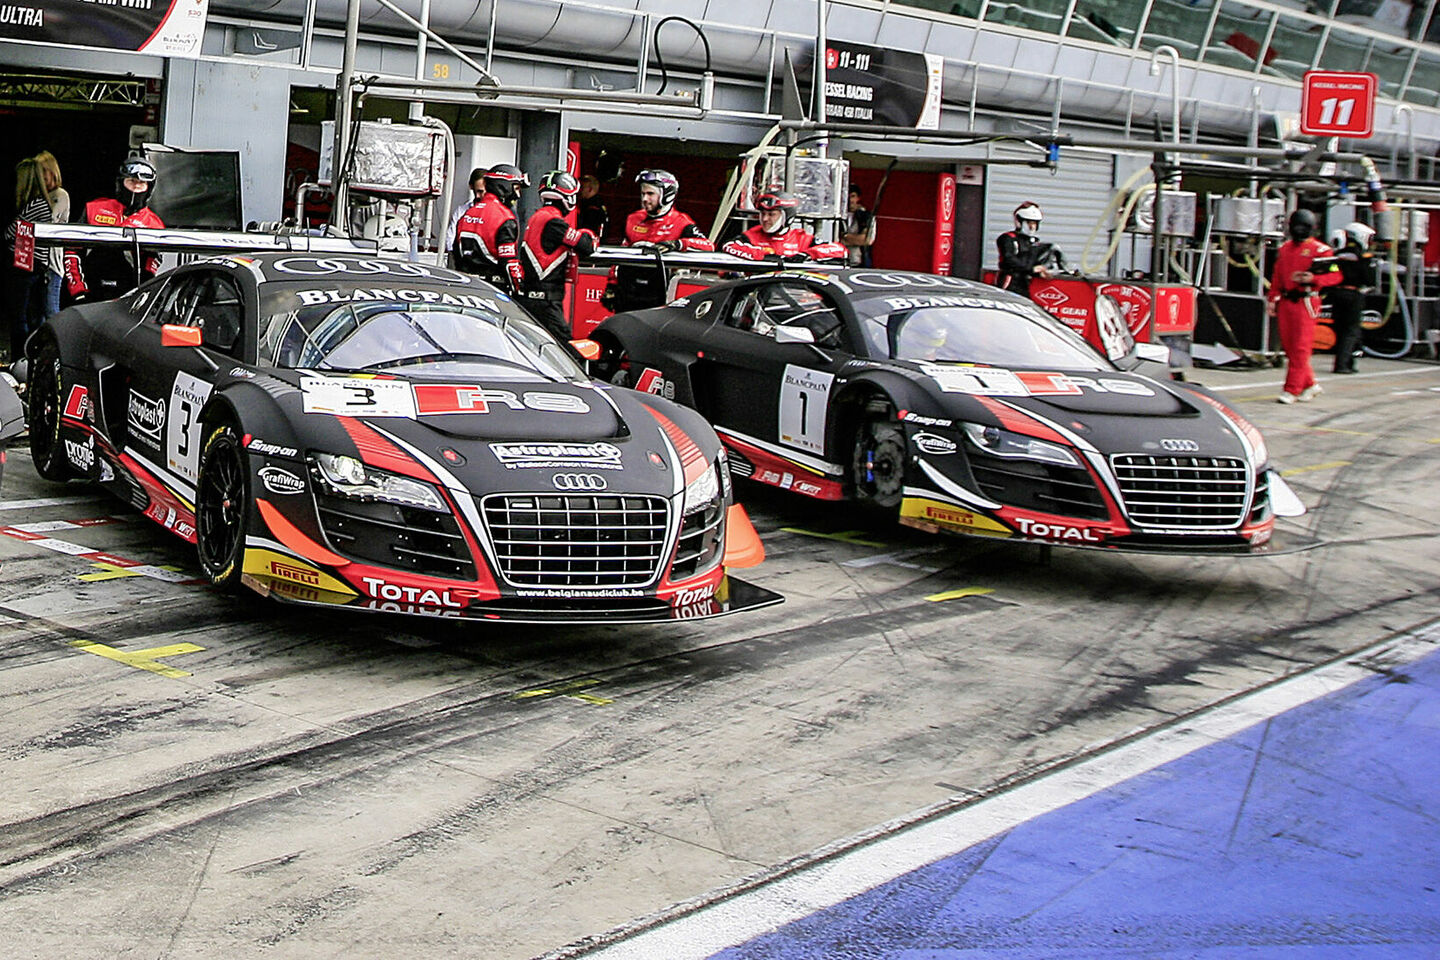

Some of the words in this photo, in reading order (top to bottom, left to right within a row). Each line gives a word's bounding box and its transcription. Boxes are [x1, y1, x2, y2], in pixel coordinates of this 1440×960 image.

[1318, 97, 1356, 126] 11
[724, 244, 755, 261] TOTAL
[295, 288, 502, 313] BLANCPAIN
[884, 296, 1041, 318] BLANCPAIN
[1060, 306, 1088, 317] GEAR
[785, 374, 829, 393] BLANCPAIN
[962, 372, 990, 389] 1
[1052, 374, 1157, 397] R8
[174, 384, 206, 406] BLANCPAIN
[339, 385, 378, 407] 3
[457, 389, 593, 414] R8
[799, 391, 809, 436] 1
[904, 411, 953, 428] Snap-on
[177, 400, 193, 458] 3
[247, 438, 298, 458] Snap-on
[497, 442, 601, 458] Astroplast
[262, 471, 306, 490] GrafiWrap
[798, 480, 823, 494] WRT
[926, 506, 974, 525] PIRELLI
[1015, 516, 1101, 542] TOTAL
[270, 560, 320, 586] PIRELLI
[362, 576, 462, 608] TOTAL
[673, 583, 714, 608] TOTAL
